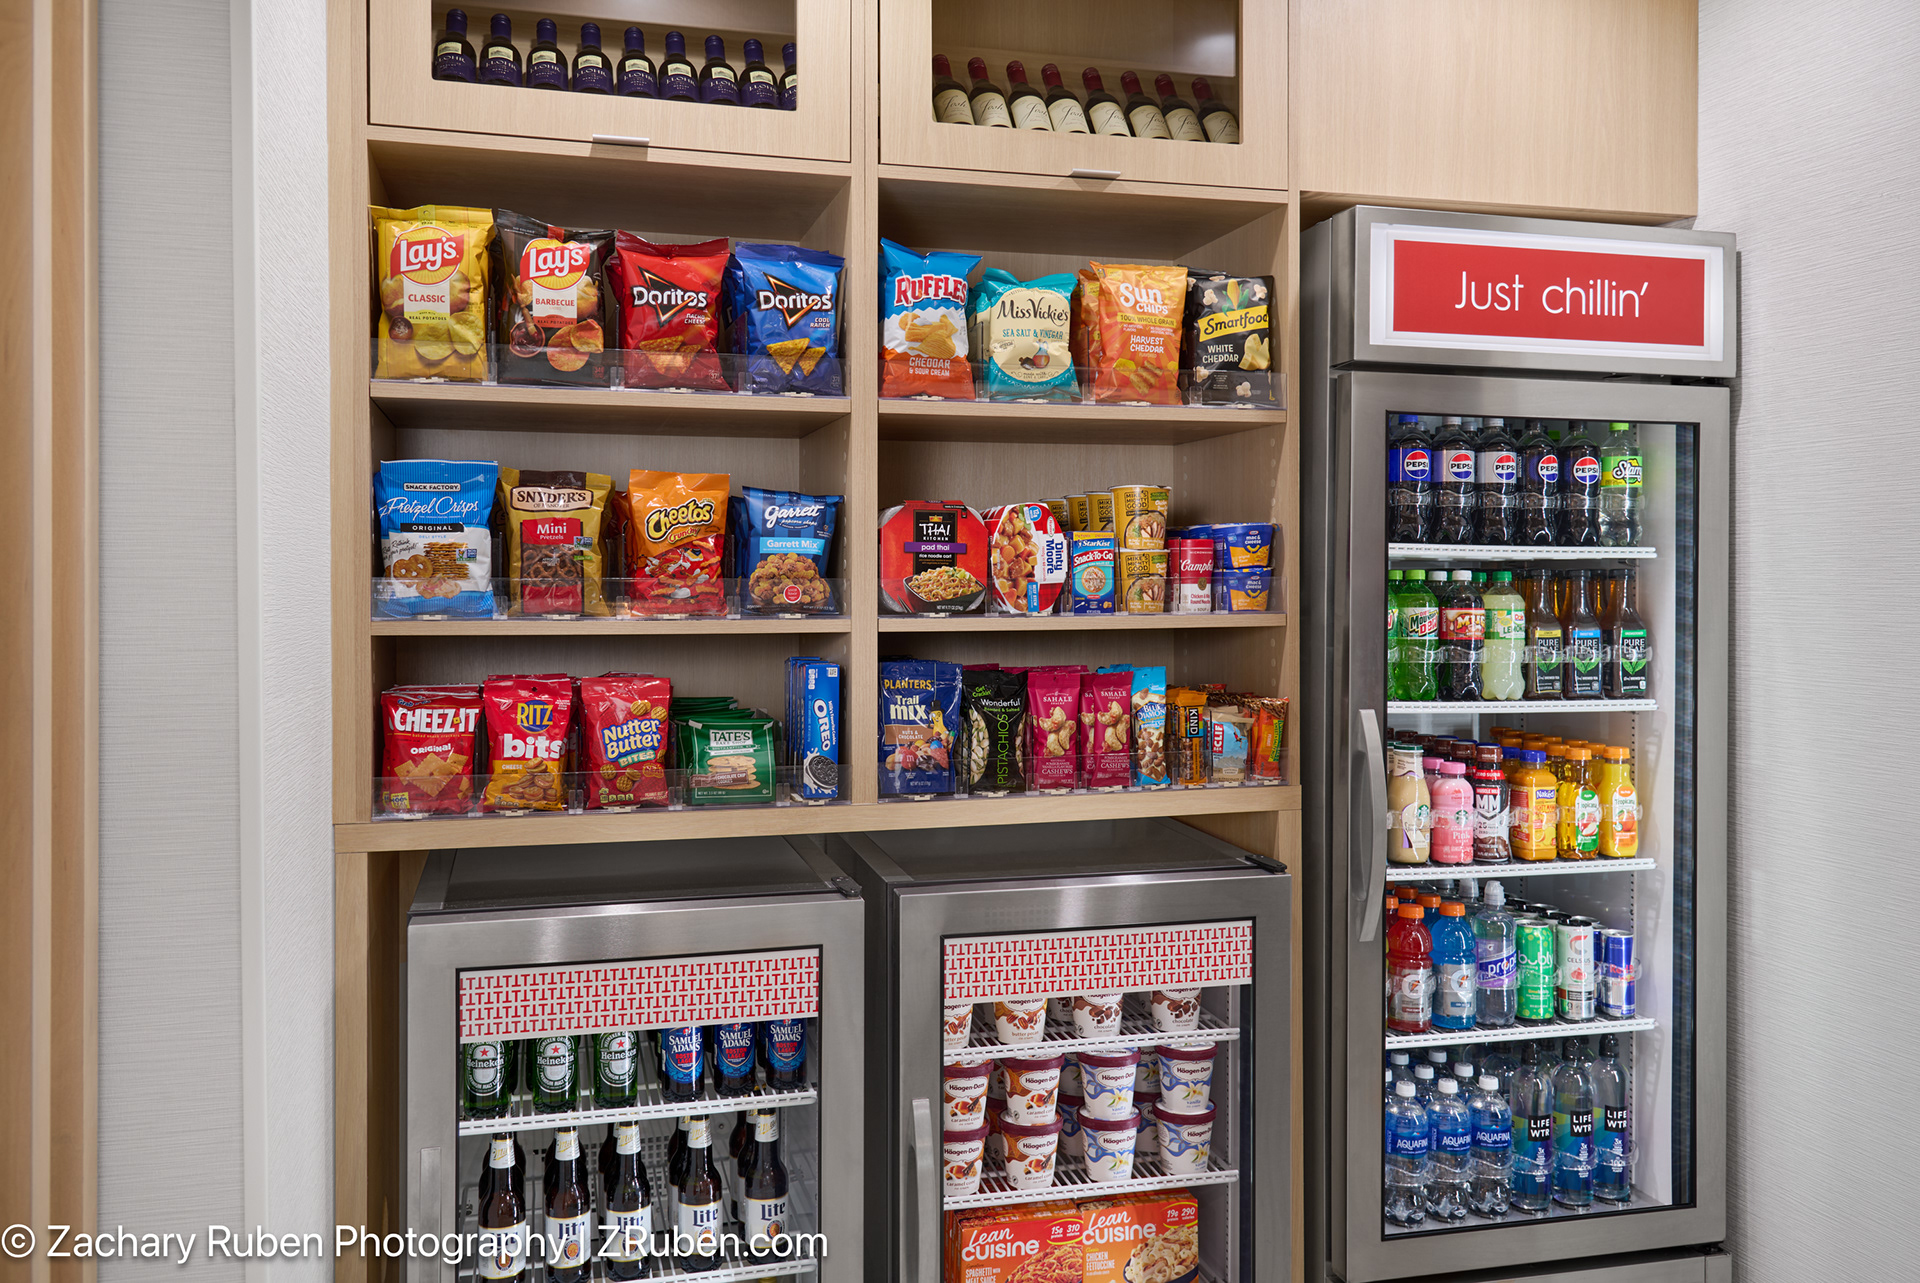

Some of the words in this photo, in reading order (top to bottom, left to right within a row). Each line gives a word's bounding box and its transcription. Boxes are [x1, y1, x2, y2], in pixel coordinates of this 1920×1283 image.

[400, 237, 456, 271] Lay's
[895, 275, 967, 305] RUFFLES
[1120, 283, 1163, 308] Sun
[1455, 271, 1524, 311] Just
[1542, 278, 1648, 317] chillin’
[408, 294, 445, 303] CLASSIC
[536, 298, 574, 306] BARBECUE
[633, 286, 707, 307] Doritos
[759, 291, 832, 310] Doritos
[1136, 302, 1168, 315] CHIPS
[1137, 316, 1156, 324] WHOLE
[1157, 318, 1175, 326] GRAIN
[1003, 329, 1015, 338] SEA
[1016, 329, 1030, 338] SALT
[1039, 330, 1064, 339] VINEGAR
[1130, 334, 1164, 345] HARVEST
[1130, 343, 1164, 354] CHEDDAR
[1207, 344, 1234, 354] WHITE
[909, 357, 950, 369] CHEDDAR
[1202, 353, 1239, 363] CHEDDAR
[517, 491, 586, 503] SNYDER'S
[436, 496, 478, 517] Crisps
[648, 501, 712, 538] Cheetos
[537, 523, 566, 534] Mini
[919, 524, 950, 536] THAI
[767, 540, 799, 548] Garrett
[801, 540, 818, 548] Mix
[1046, 540, 1054, 574] Moore
[1055, 541, 1063, 570] Dinty
[1128, 565, 1149, 573] GOOD
[884, 680, 932, 690] PLANTERS
[896, 696, 919, 705] Trail
[981, 698, 1020, 706] Wonderful
[517, 703, 553, 726] RITZ
[890, 705, 928, 720] mix
[813, 699, 831, 751] OREO
[1189, 709, 1198, 735] KIND
[603, 720, 660, 744] Nutter
[711, 732, 750, 741] TATE'S
[1214, 724, 1224, 746] CLIF
[503, 734, 565, 759] bits
[607, 734, 660, 759] Butter
[997, 714, 1009, 784] PISTACHIOS
[620, 750, 655, 766] BITES
[1536, 790, 1555, 799] Naked
[1477, 795, 1499, 811] MM
[770, 1023, 803, 1034] SAMUEL
[720, 1029, 753, 1041] SAMUEL
[772, 1032, 801, 1042] ADAMS
[722, 1038, 750, 1048] ADAMS
[537, 1053, 574, 1065] Heineken
[601, 1049, 636, 1060] Heineken
[1573, 1114, 1592, 1123] LIFE
[1607, 1110, 1627, 1119] LIFE
[1531, 1118, 1550, 1127] LIFE
[1607, 1120, 1627, 1129] WTR
[1531, 1129, 1550, 1138] WTR
[1573, 1125, 1592, 1133] WTR
[1476, 1132, 1510, 1143] AQUAFINA
[692, 1208, 719, 1226] Lite
[761, 1202, 785, 1221] Lite
[1181, 1207, 1195, 1216] 290
[1089, 1211, 1131, 1231] Lean
[1067, 1224, 1080, 1232] 310
[969, 1228, 1014, 1248] Lean
[1086, 1252, 1108, 1261] CHICKEN
[1086, 1260, 1115, 1271] FETTUCCINE
